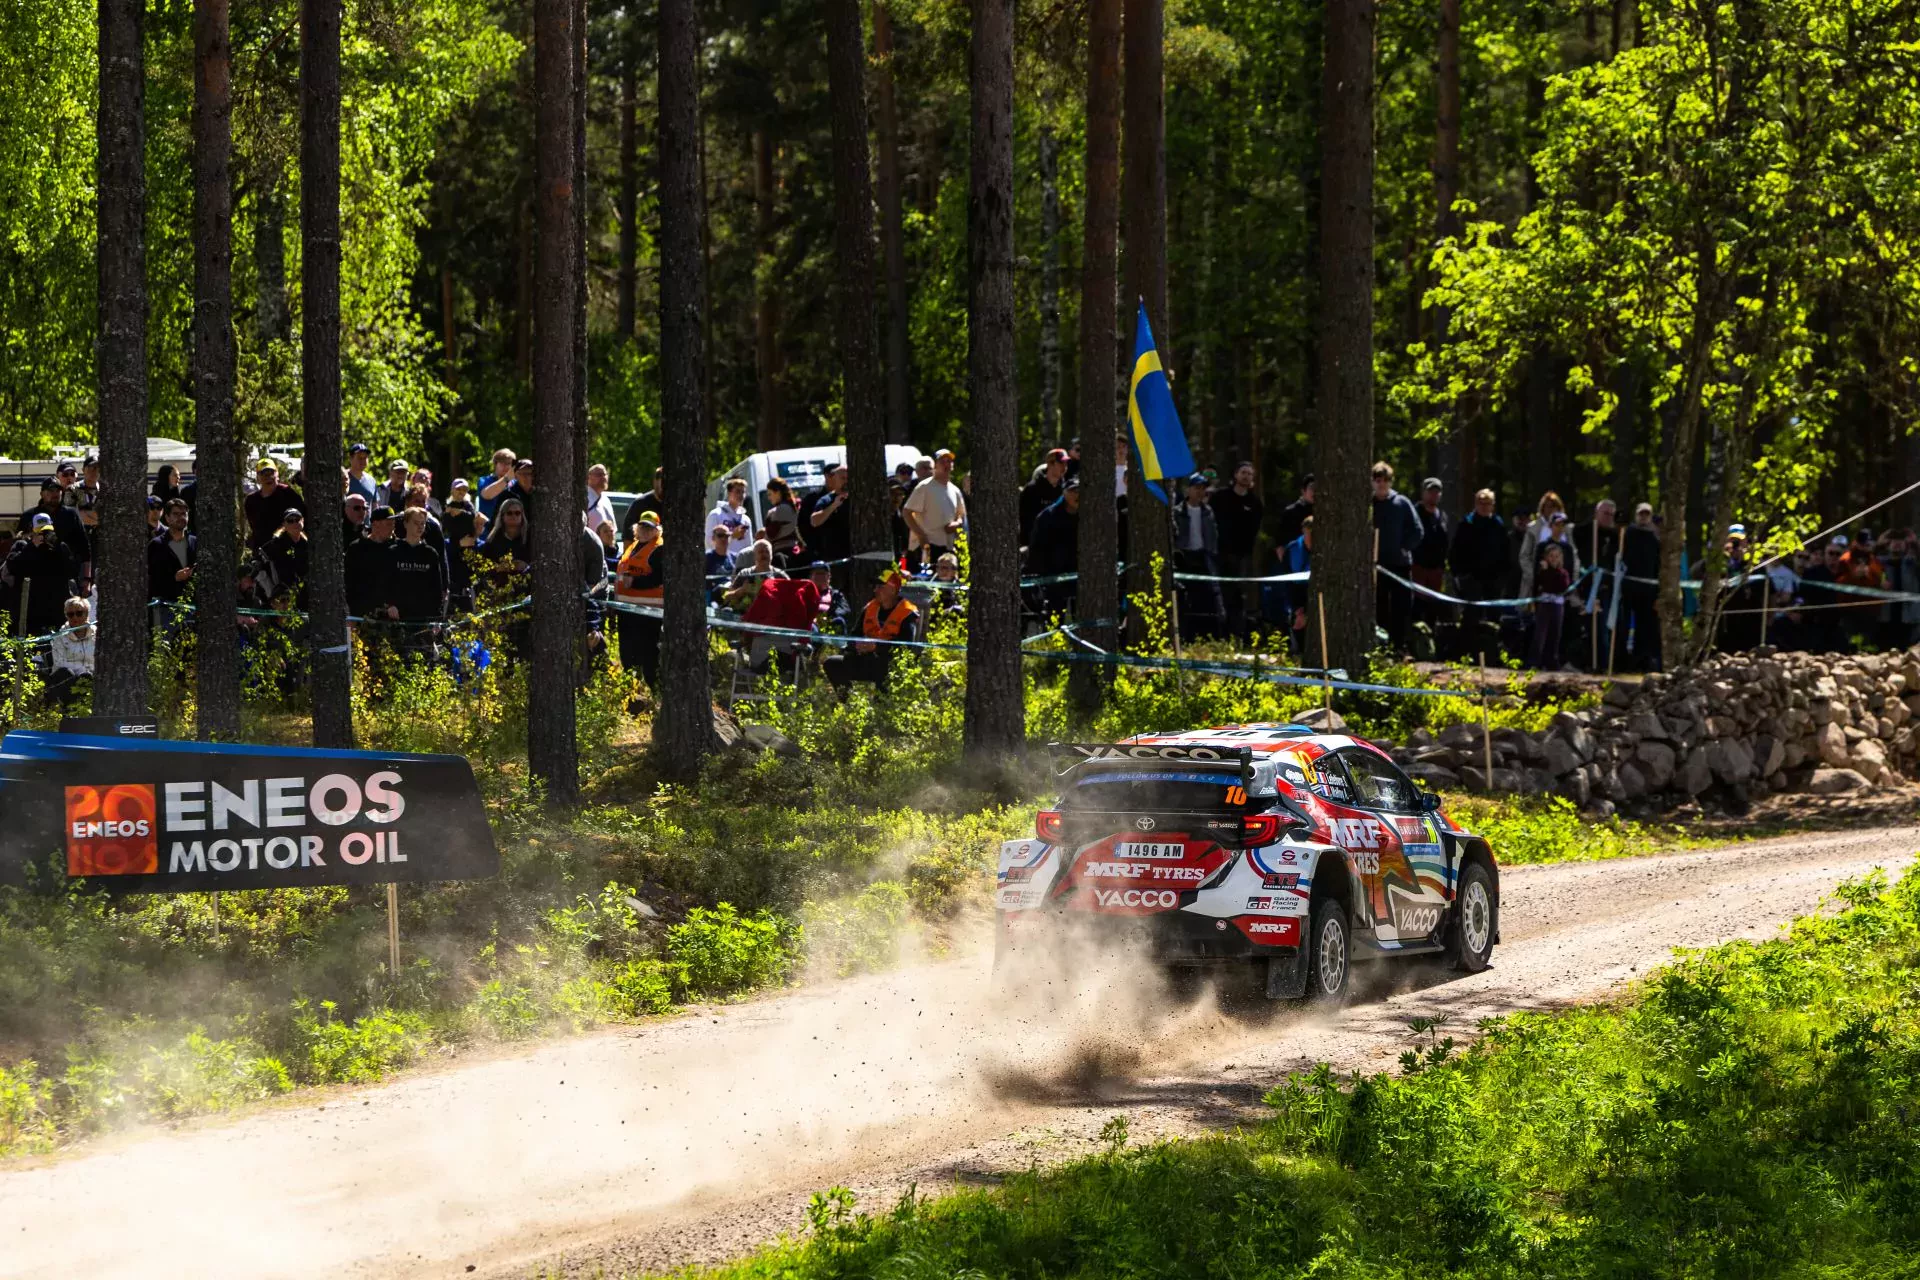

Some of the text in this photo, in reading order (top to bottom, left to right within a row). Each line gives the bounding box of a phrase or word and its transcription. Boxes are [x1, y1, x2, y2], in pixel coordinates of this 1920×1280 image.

[1073, 746, 1221, 760] YACCO
[165, 771, 406, 832] ENEOS
[1224, 785, 1248, 806] 10
[73, 819, 149, 838] ENEOS
[1324, 818, 1382, 849] MRF
[168, 831, 408, 873] MOTOR OIL
[1163, 845, 1182, 857] AM
[1083, 861, 1205, 880] MRF TYRES
[1265, 873, 1298, 886] ETS
[1094, 889, 1178, 908] YACCO
[1247, 901, 1270, 909] GR
[1249, 922, 1291, 934] MRF
[1400, 907, 1438, 933] YACCO
